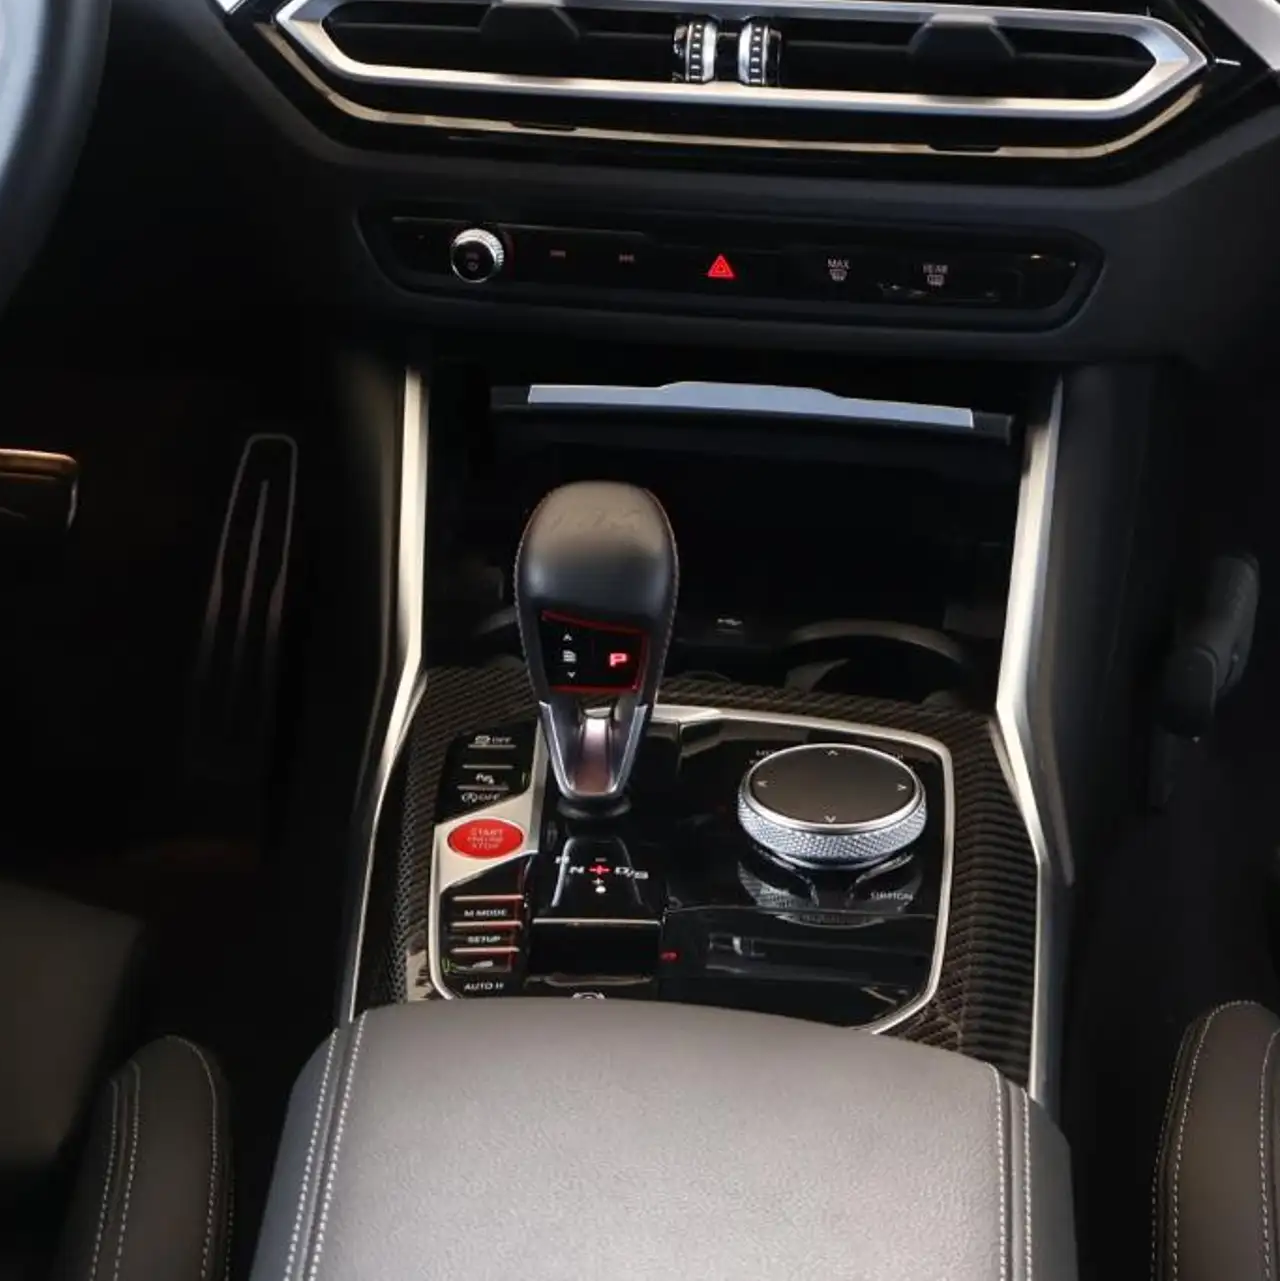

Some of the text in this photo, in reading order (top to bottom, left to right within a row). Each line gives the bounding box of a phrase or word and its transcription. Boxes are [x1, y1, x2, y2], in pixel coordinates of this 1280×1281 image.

[827, 258, 851, 269] MAX
[609, 652, 628, 667] P
[471, 828, 504, 836] START
[569, 866, 585, 875] N
[467, 935, 502, 944] SETUP
[464, 982, 493, 991] AUTO
